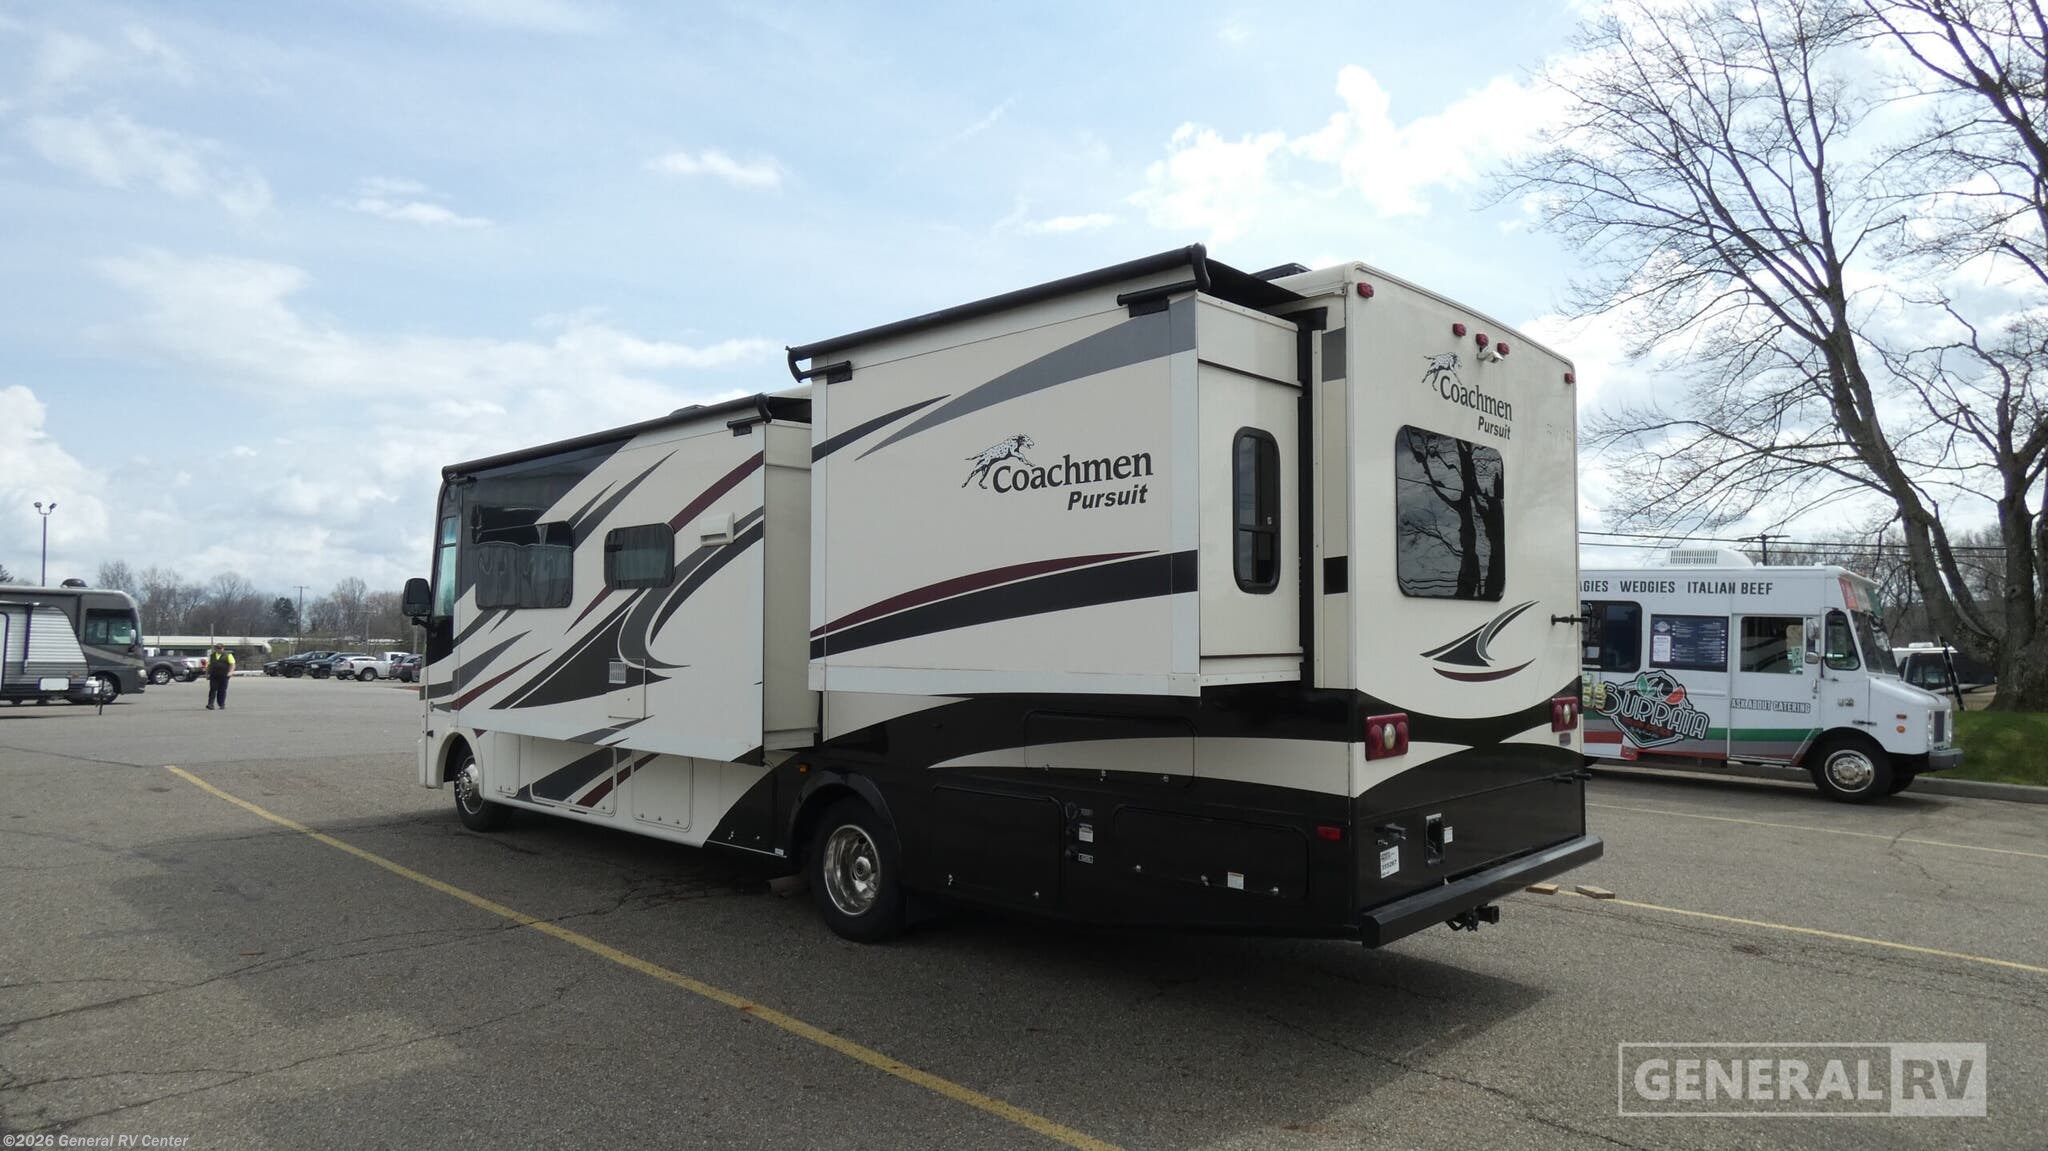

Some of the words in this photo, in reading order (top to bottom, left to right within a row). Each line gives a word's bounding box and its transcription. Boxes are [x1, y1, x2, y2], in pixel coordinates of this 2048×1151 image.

[1439, 375, 1513, 422] Coachmen
[1477, 415, 1511, 440] Pursuit
[992, 452, 1154, 494] Coachmen
[1067, 483, 1149, 511] Pursuit
[1619, 580, 1676, 593] WEDGIES
[1687, 581, 1736, 595] ITALIAN
[1740, 582, 1774, 595] BEEF
[1772, 700, 1811, 713] CATERING
